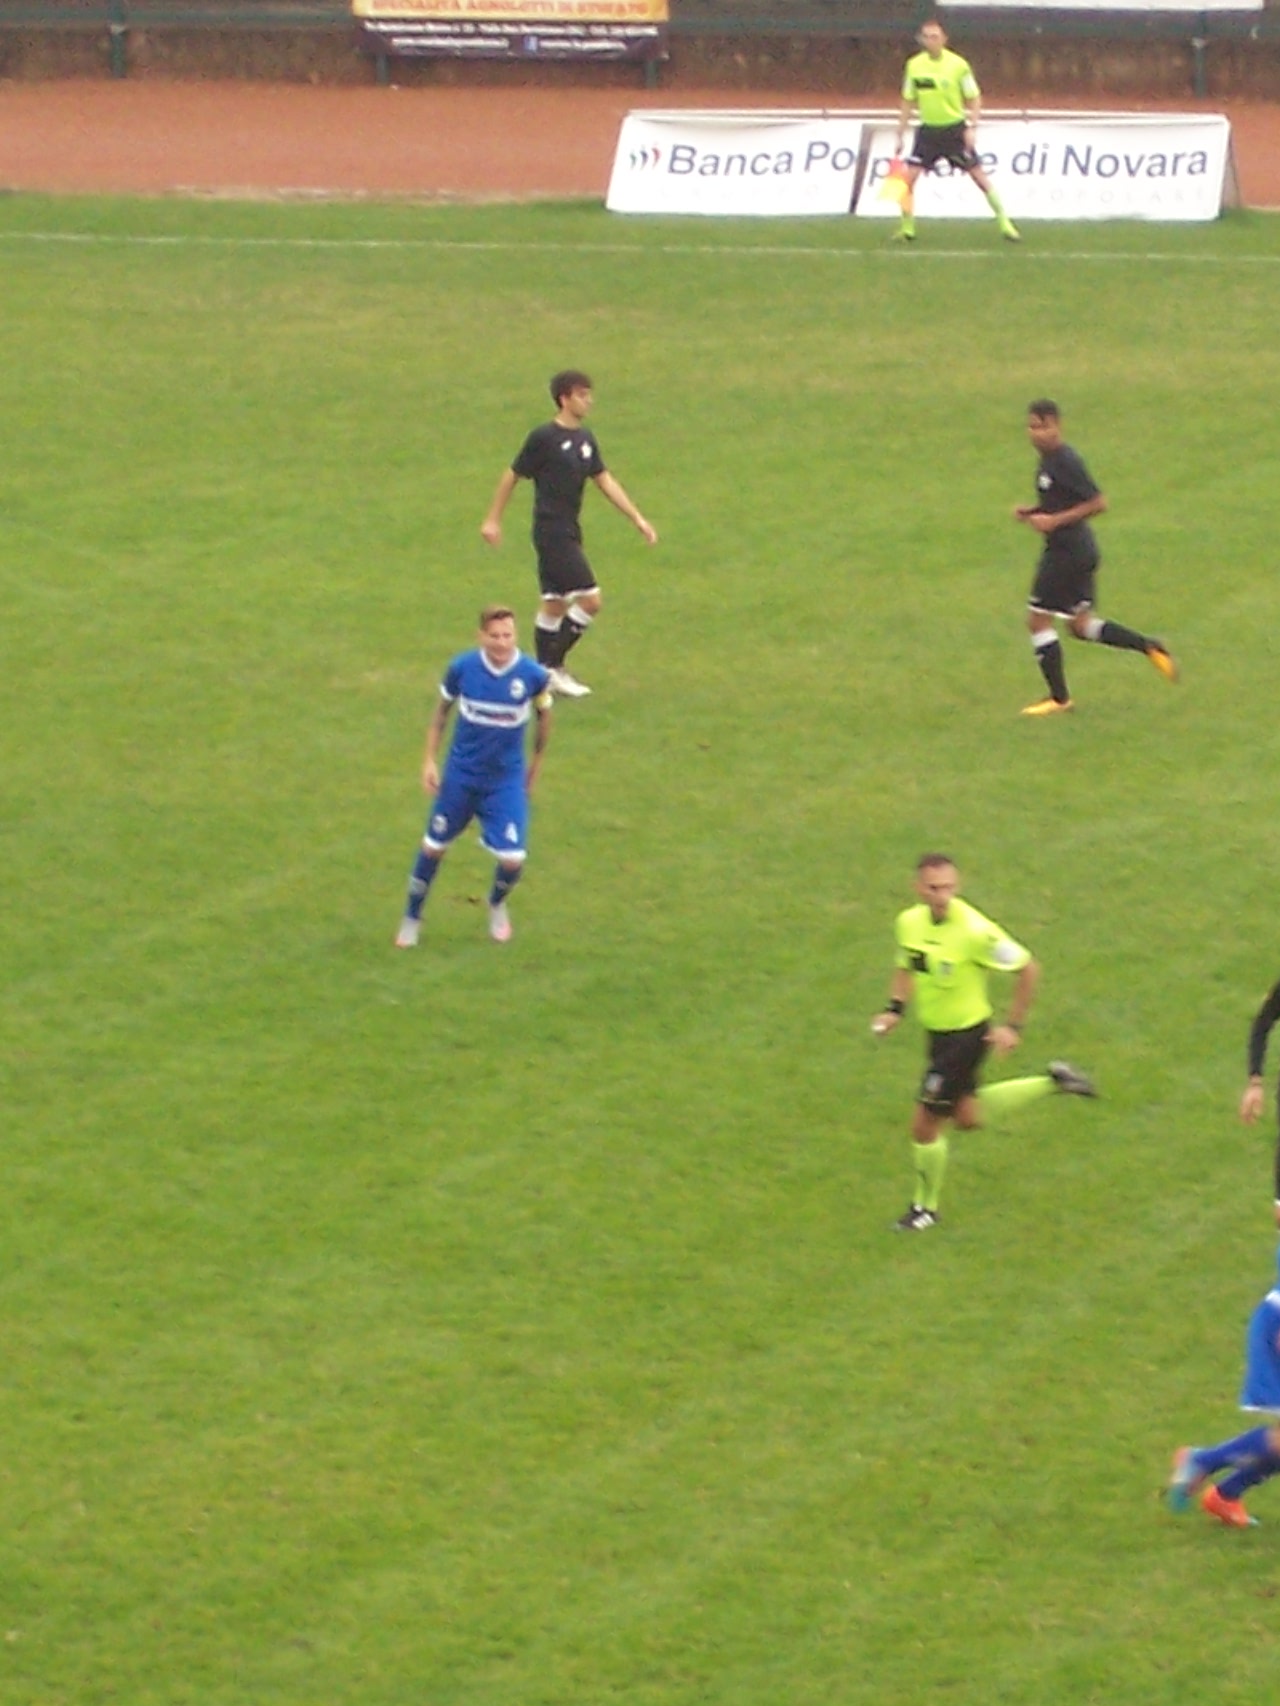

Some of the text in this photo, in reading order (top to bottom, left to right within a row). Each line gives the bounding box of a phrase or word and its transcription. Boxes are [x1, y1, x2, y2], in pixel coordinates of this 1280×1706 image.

[667, 144, 794, 177] Banca
[1011, 142, 1050, 176] di
[1061, 145, 1208, 178] Novara
